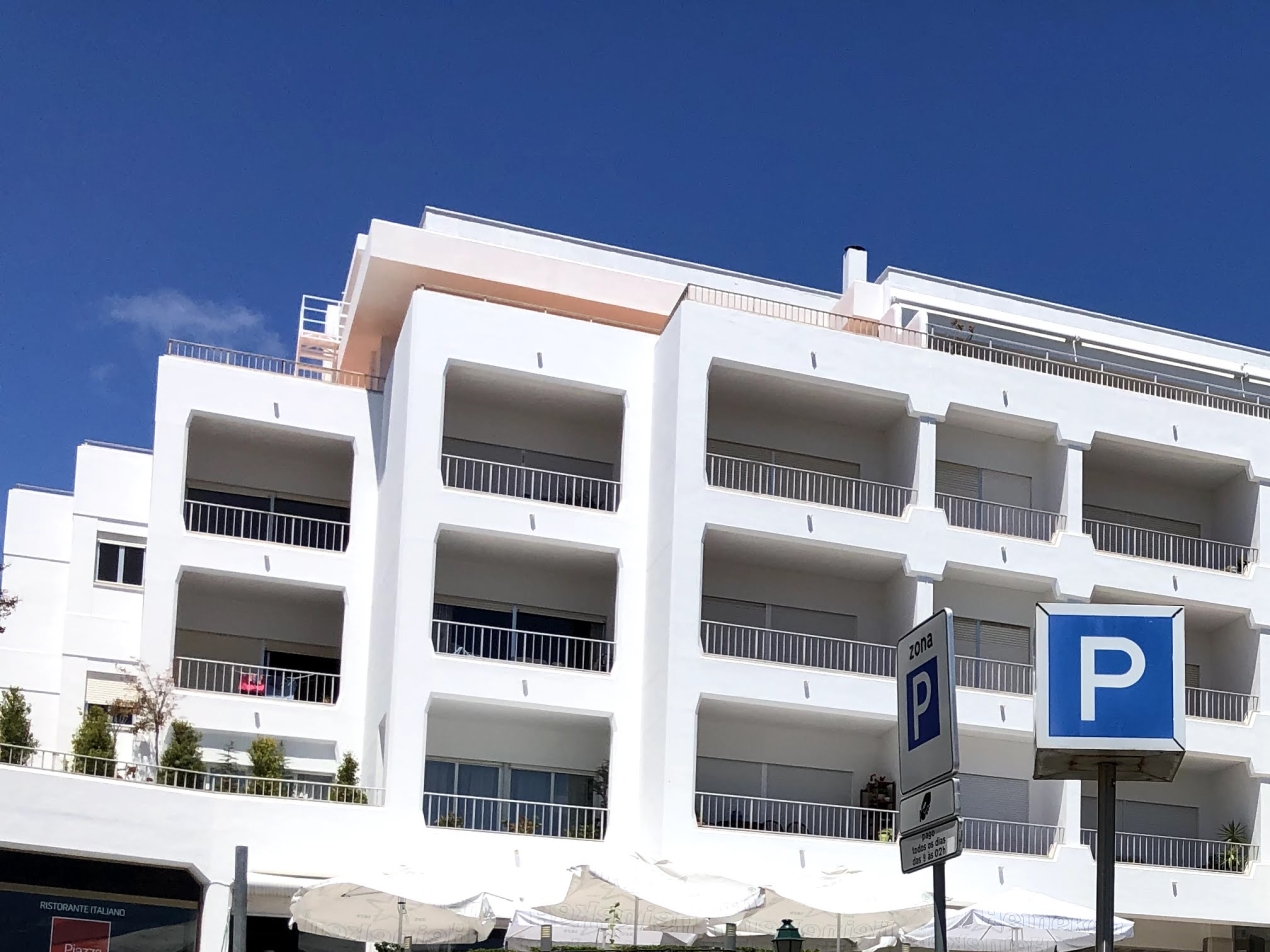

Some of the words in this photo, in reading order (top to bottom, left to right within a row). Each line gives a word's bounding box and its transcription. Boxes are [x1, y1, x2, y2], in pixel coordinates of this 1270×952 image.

[908, 632, 934, 661] zona
[1080, 636, 1146, 721] P
[912, 670, 932, 741] P
[911, 843, 927, 855] todos
[927, 841, 935, 850] os
[935, 836, 946, 847] dias
[921, 830, 936, 842] pago
[912, 857, 922, 866] das
[39, 901, 90, 914] RISTORANTE
[90, 907, 126, 917] ITALIANO
